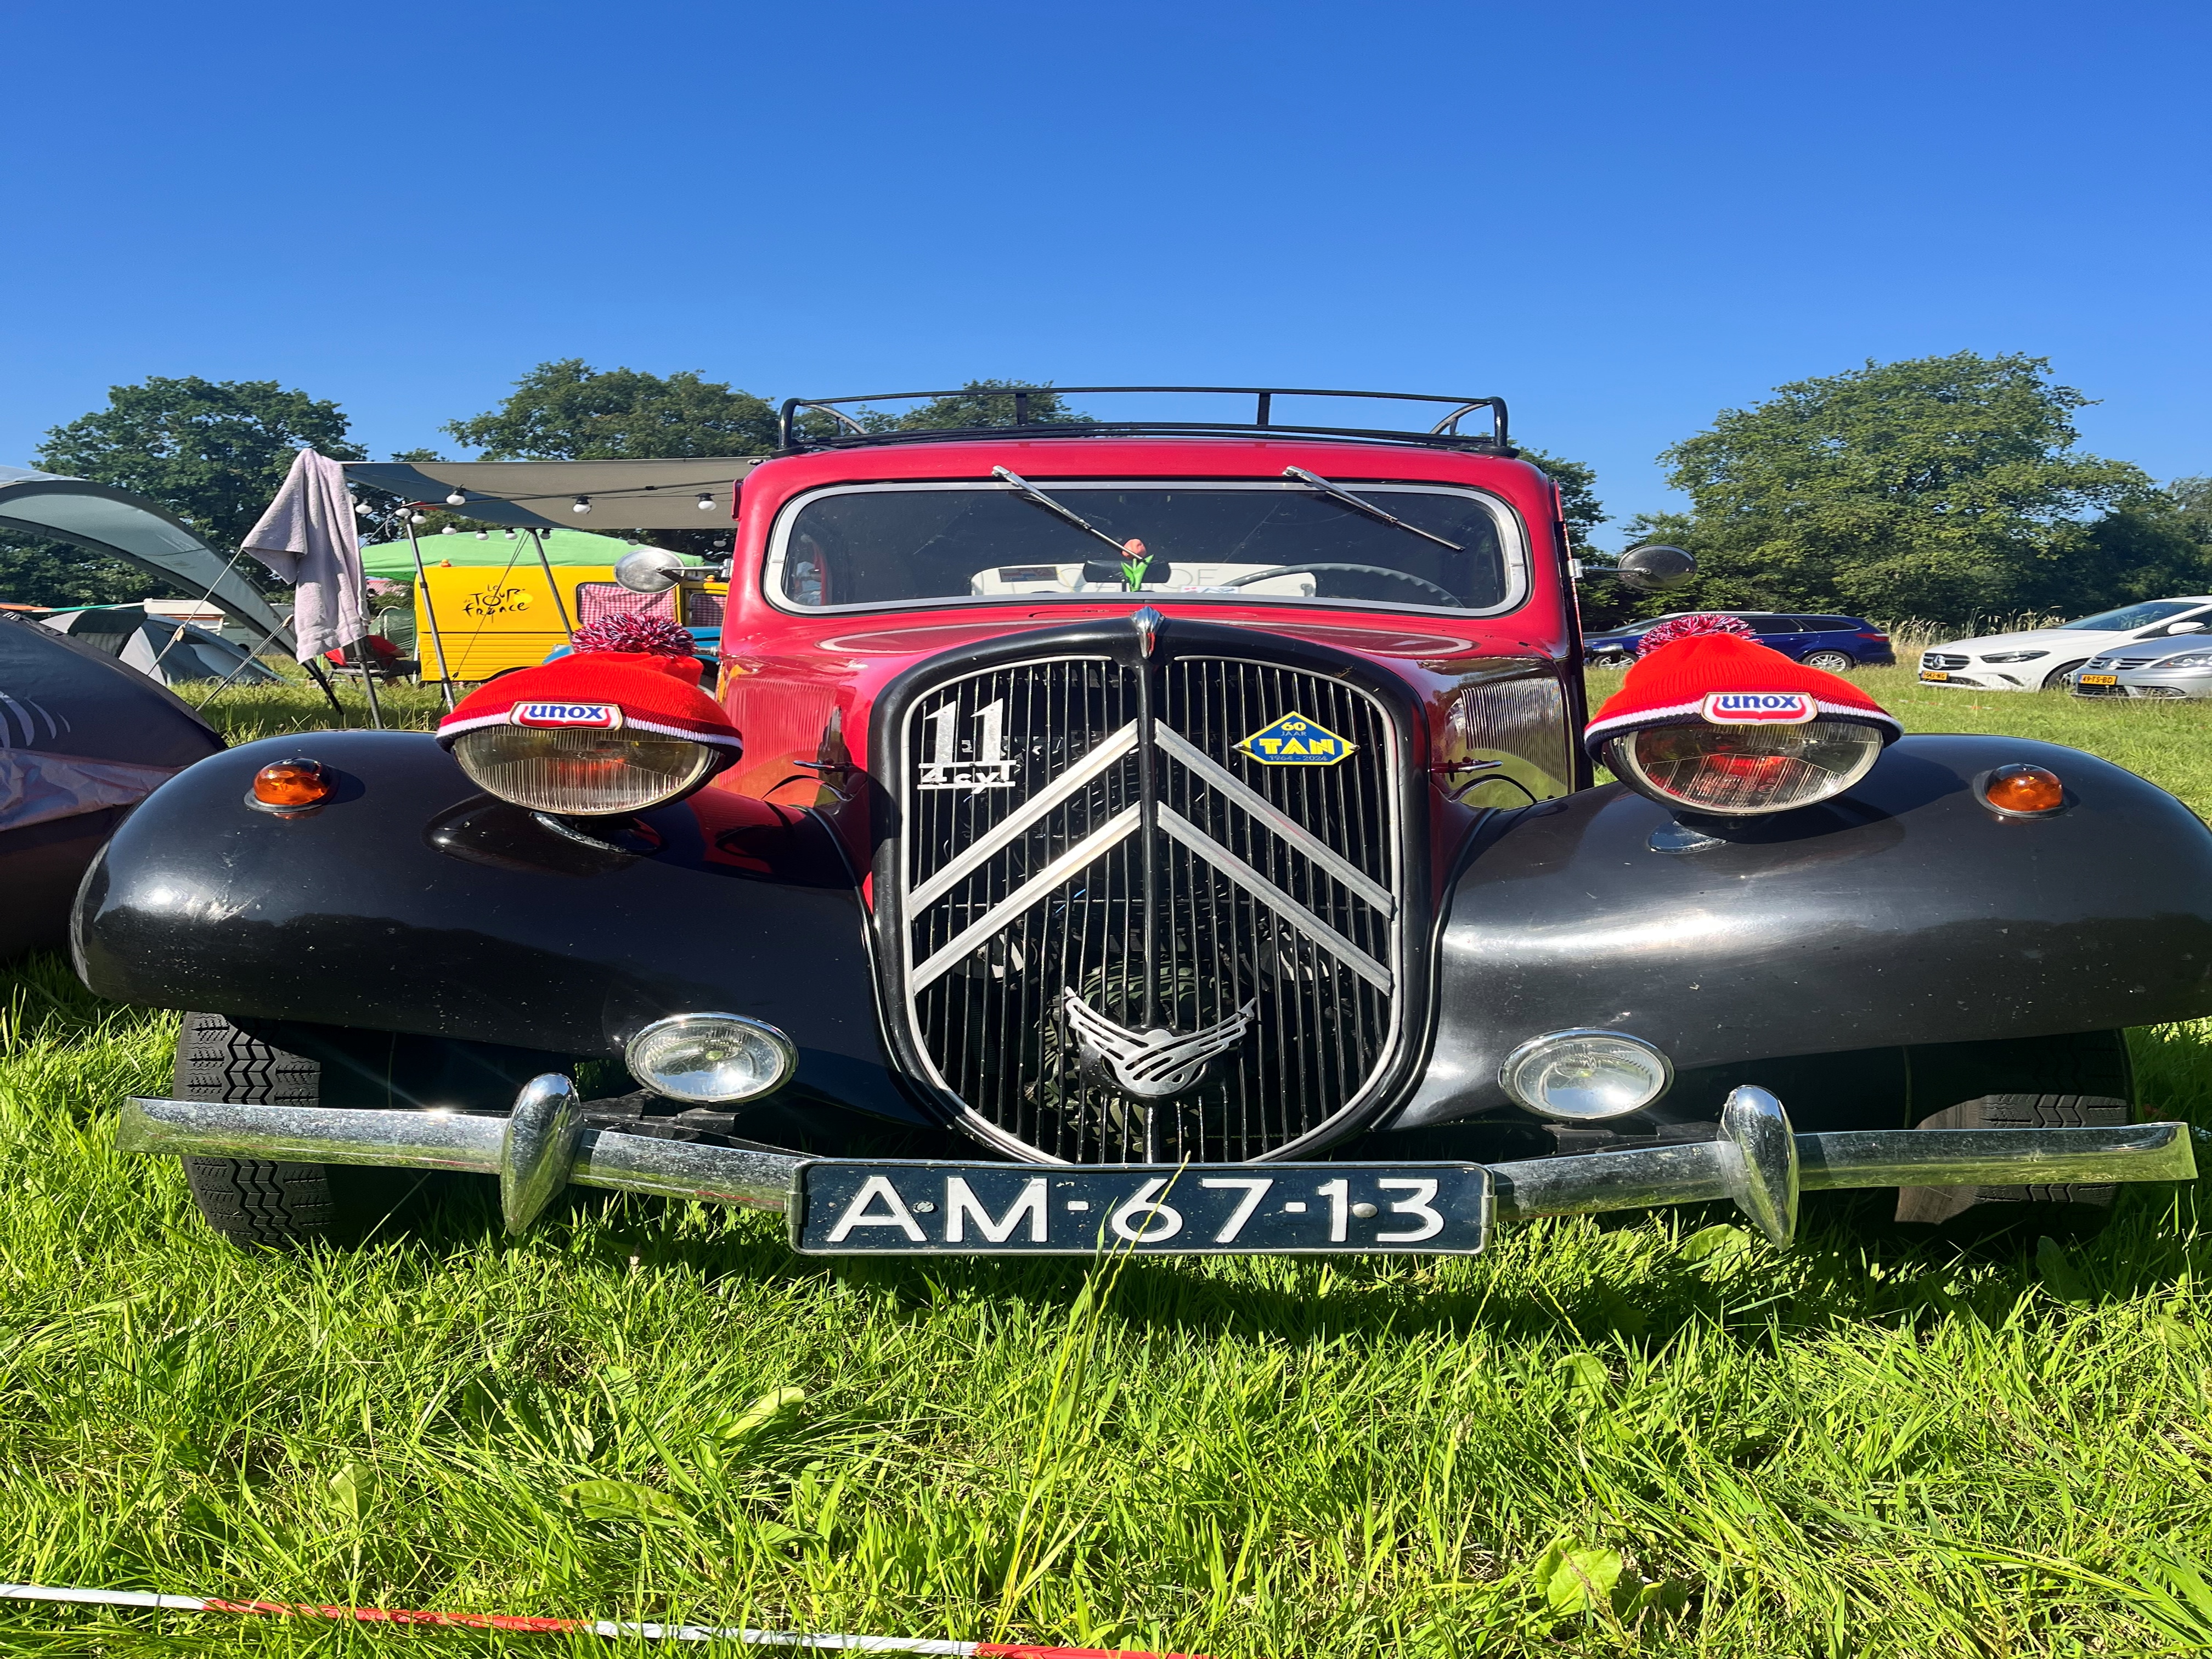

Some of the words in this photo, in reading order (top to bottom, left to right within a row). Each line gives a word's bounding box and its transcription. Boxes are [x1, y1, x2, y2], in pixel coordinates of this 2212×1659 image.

[1722, 695, 1798, 709] unox
[529, 705, 603, 719] unox
[924, 697, 1003, 764] 11
[1280, 721, 1307, 731] 60
[1258, 737, 1335, 755] TAN
[826, 1176, 1445, 1243] AM-67-13
